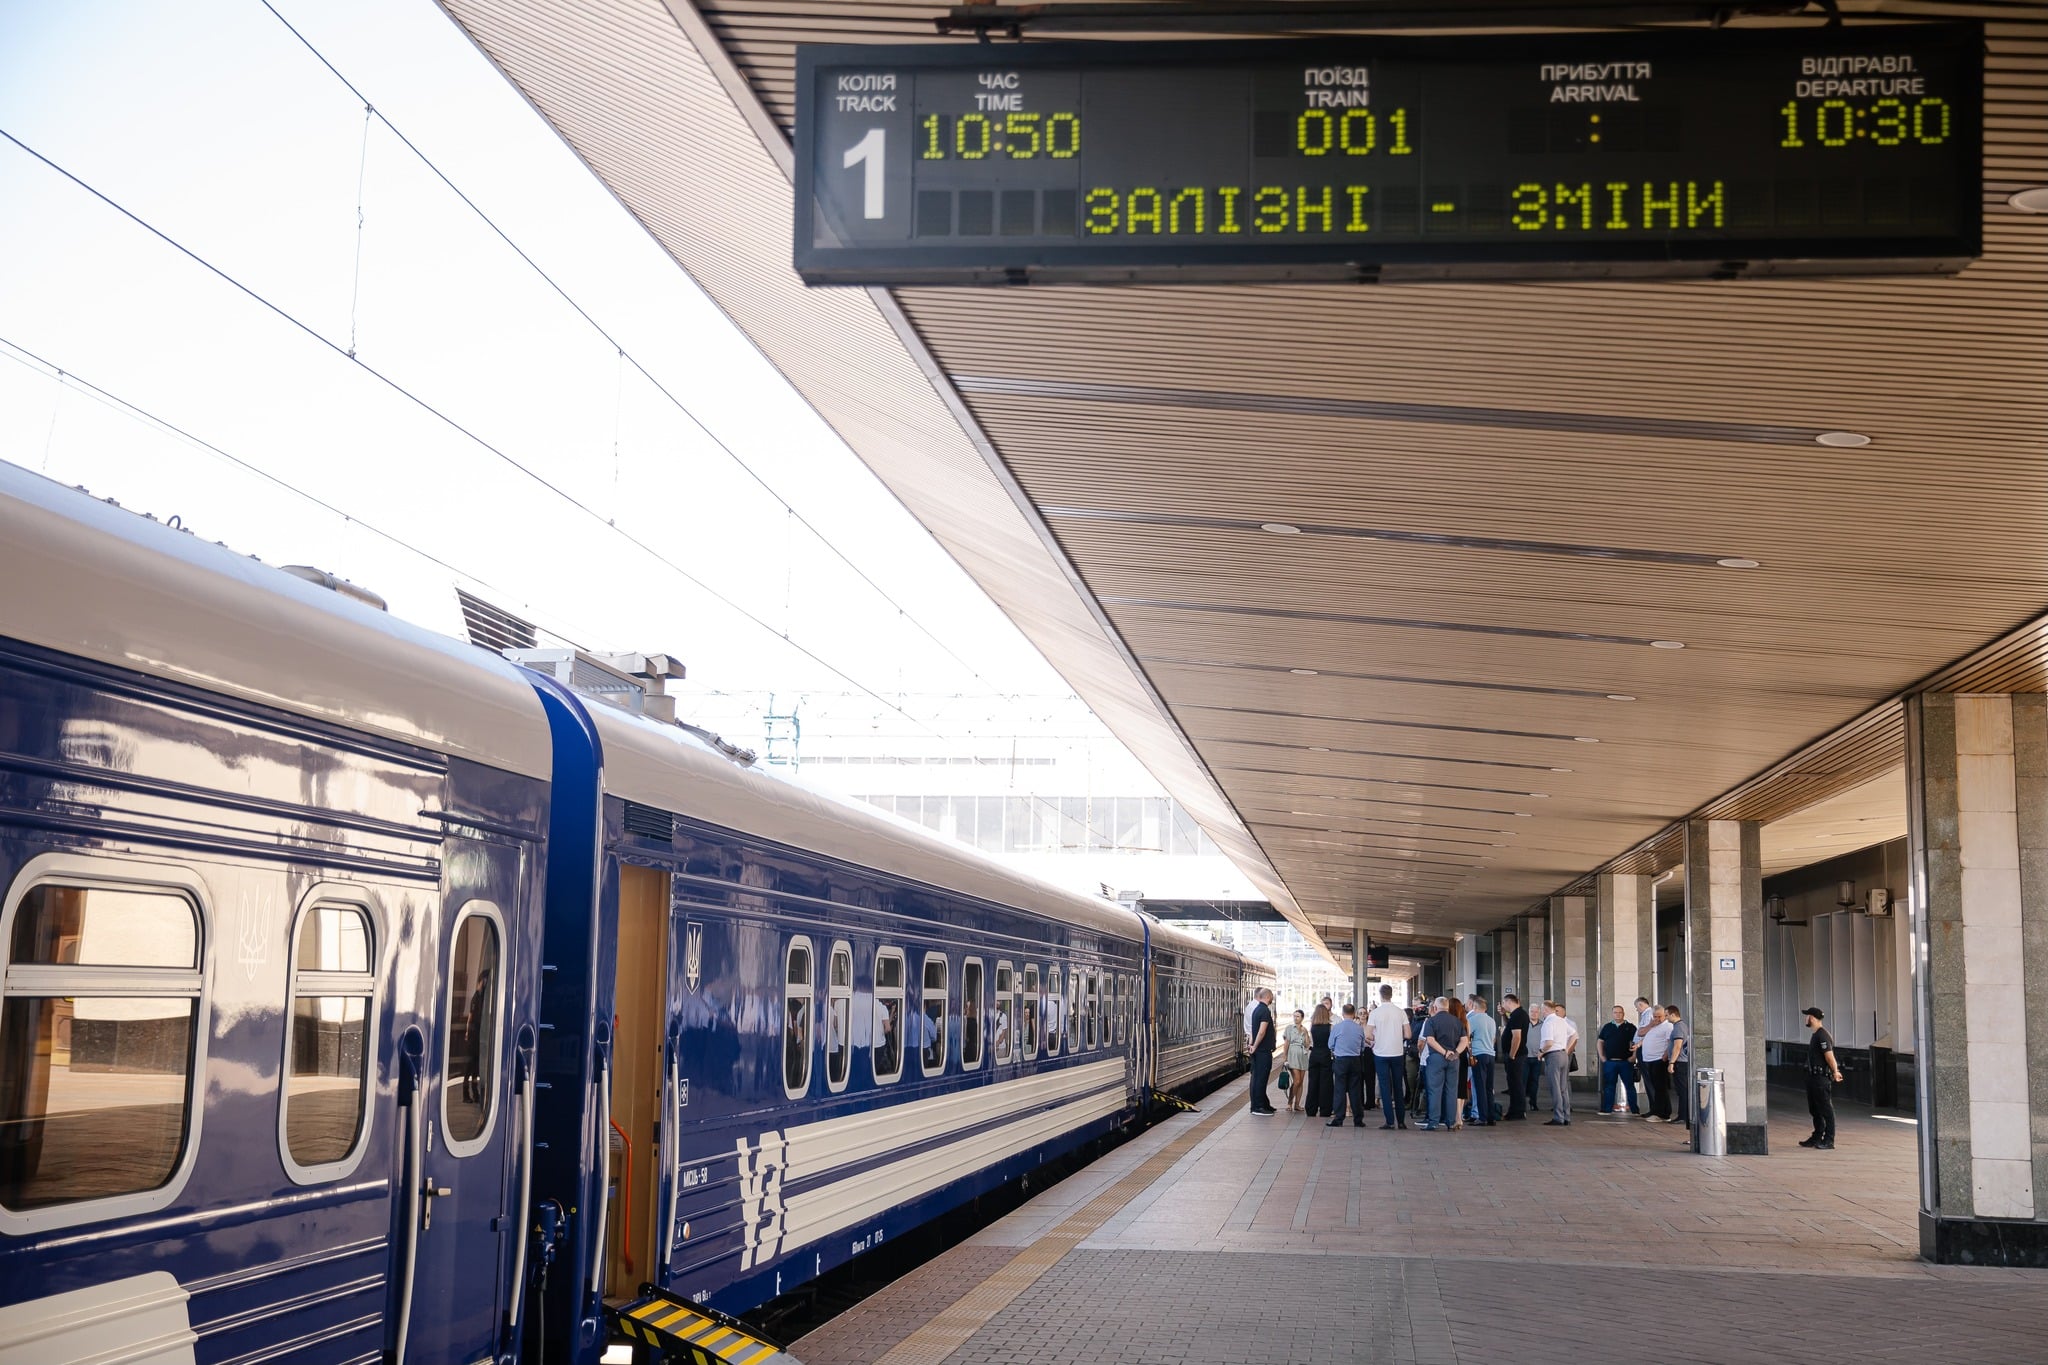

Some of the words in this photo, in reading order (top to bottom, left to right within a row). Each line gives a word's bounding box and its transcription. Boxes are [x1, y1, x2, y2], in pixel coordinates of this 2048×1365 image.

[1541, 63, 1651, 81] ПРИБУТТЯ
[1803, 56, 1916, 76] ВІДПРАВЛ.
[837, 74, 897, 92] КОЛІЯ
[978, 73, 1020, 90] ЧАС
[1304, 66, 1369, 88] ПОЇЗД
[1550, 85, 1640, 102] ARRIVAL
[1796, 78, 1924, 97] DEPARTURE
[836, 95, 897, 113] TRACK
[974, 93, 1024, 112] TIME
[1304, 90, 1369, 109] TRAIN
[1296, 107, 1412, 156] 001
[1780, 97, 1950, 147] 10:30
[923, 112, 1080, 159] 10:50
[843, 128, 886, 220] 1
[1085, 185, 1369, 235] ЗАЛІЗНІ
[1511, 180, 1724, 231] ЗМІНИ
